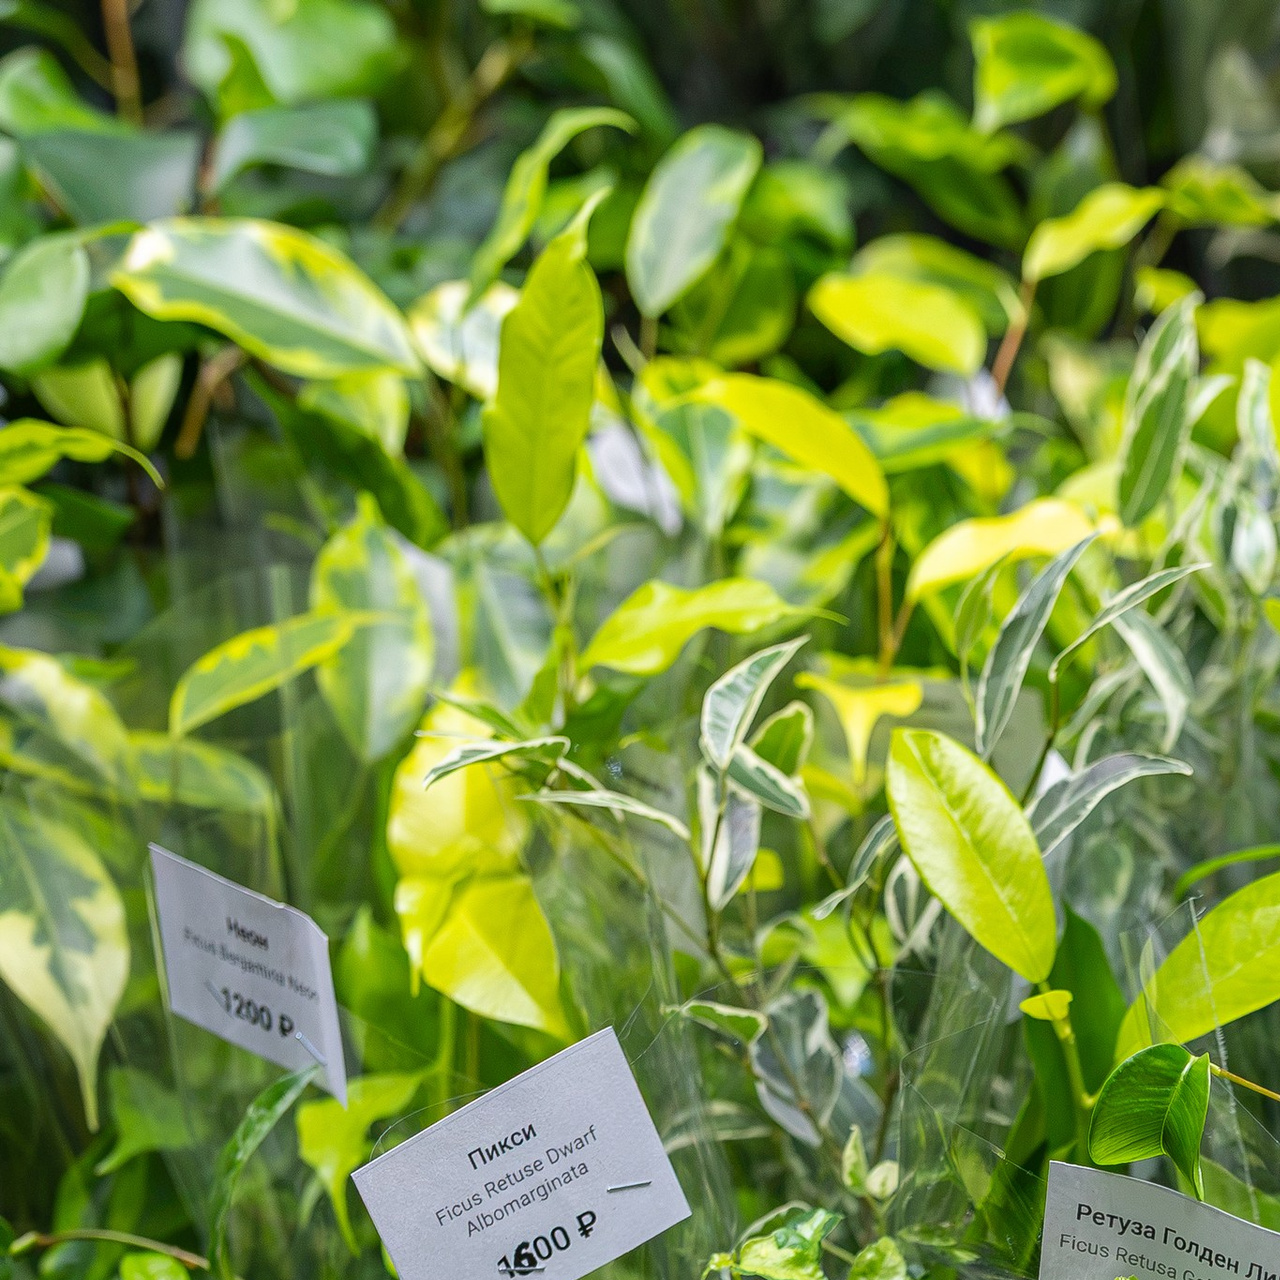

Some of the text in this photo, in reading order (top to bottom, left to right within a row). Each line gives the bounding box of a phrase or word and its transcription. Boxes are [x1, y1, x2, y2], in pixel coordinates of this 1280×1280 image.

[220, 987, 273, 1032] 1200
[467, 1124, 537, 1170] Пикси
[435, 1124, 598, 1226] Ficus Retuse Dwarf
[467, 1161, 589, 1237] Albomarginata
[497, 1226, 571, 1279] 1600
[1059, 1233, 1110, 1258] Ficus
[1115, 1246, 1177, 1280] Retusa
[1076, 1203, 1156, 1240] Ретуза
[1163, 1227, 1240, 1273] Голден
